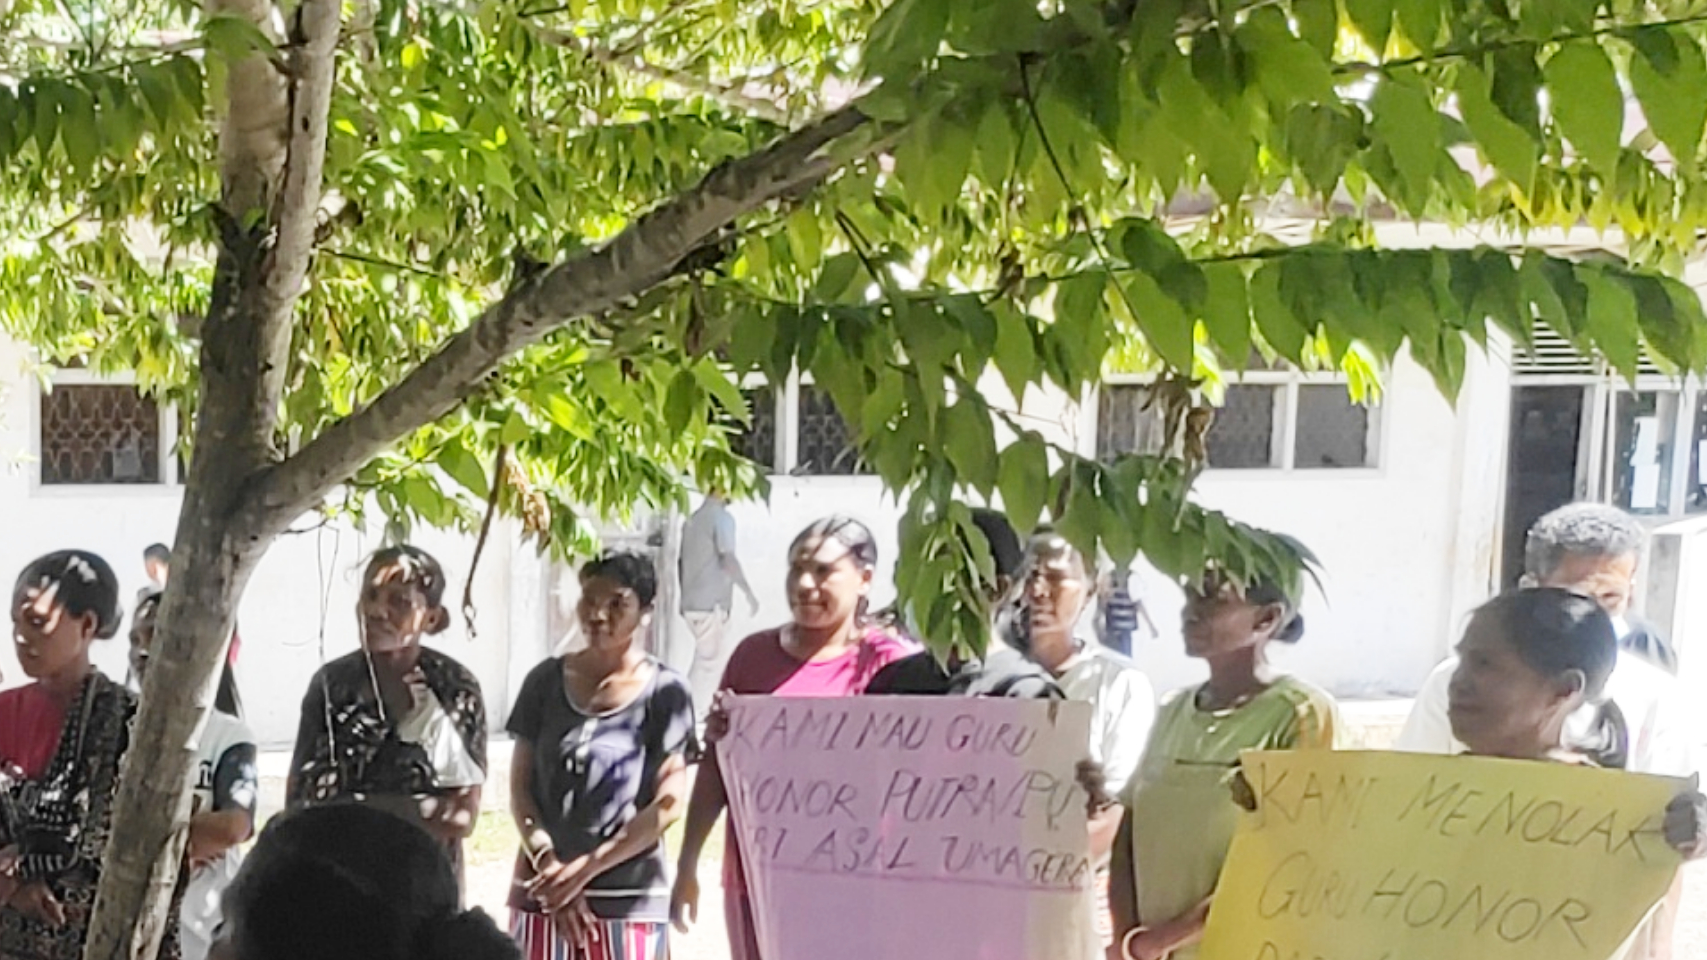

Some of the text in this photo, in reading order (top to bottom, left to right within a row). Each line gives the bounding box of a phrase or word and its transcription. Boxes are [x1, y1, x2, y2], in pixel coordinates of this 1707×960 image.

[732, 706, 1038, 758] KAMI MAU GURU
[1398, 773, 1662, 862] MENOLAK
[1258, 851, 1593, 949] GURU HONOR
